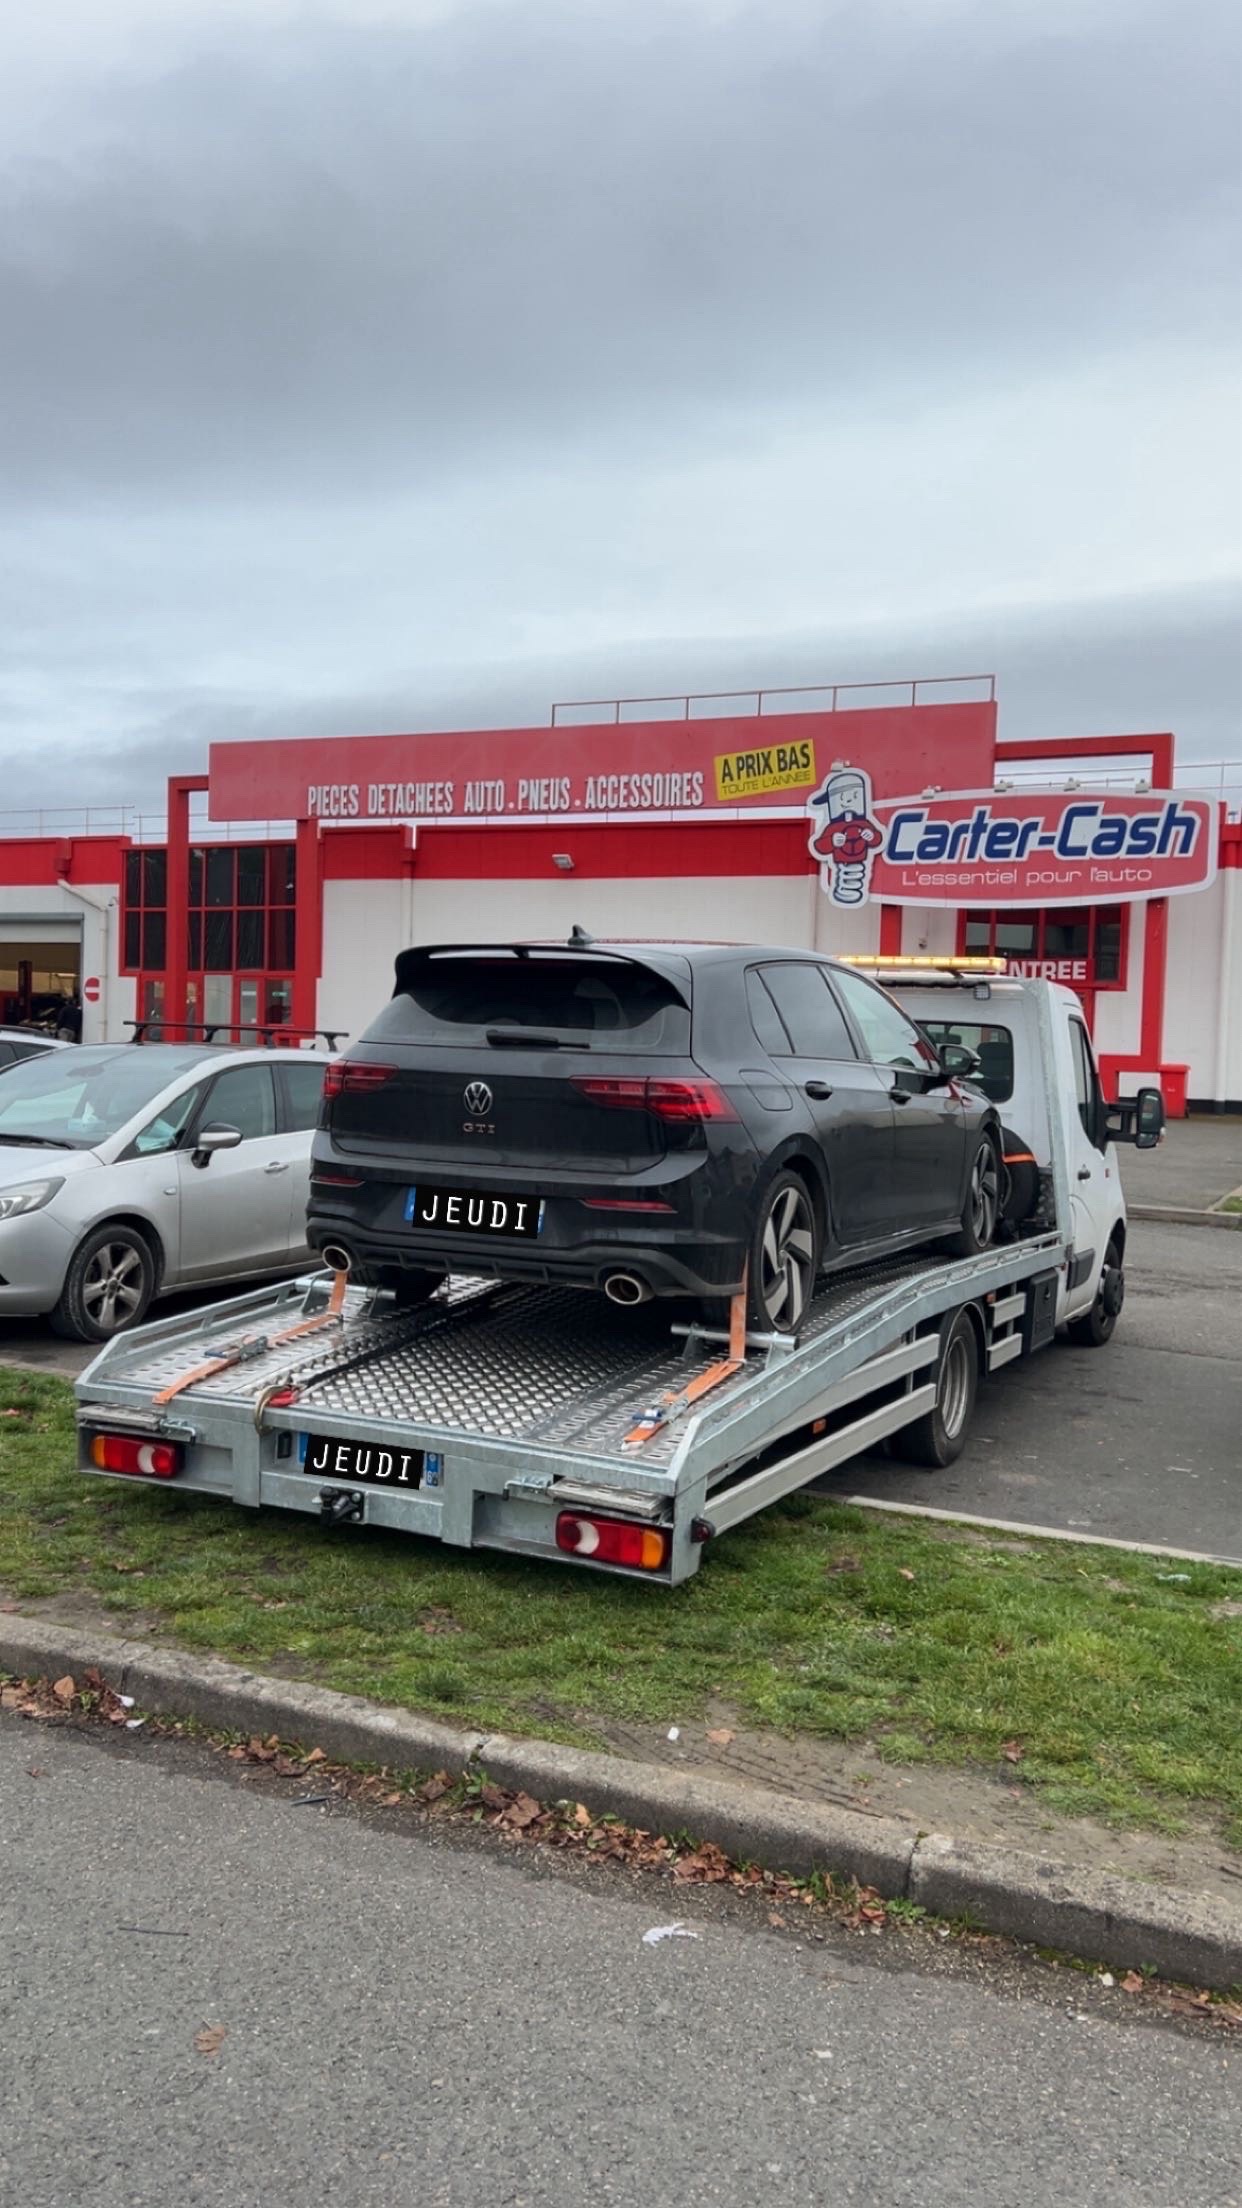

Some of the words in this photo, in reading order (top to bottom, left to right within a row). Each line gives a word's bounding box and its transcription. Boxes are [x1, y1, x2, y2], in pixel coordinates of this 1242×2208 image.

[721, 758, 734, 783] A
[736, 751, 773, 780] PRIX
[776, 743, 810, 773] BAS
[308, 783, 359, 816] PIECES
[368, 781, 454, 815] DETACHEES
[464, 779, 504, 813] AUTO
[518, 777, 570, 811] PNEUS
[585, 771, 704, 809] ACCESSOIRES
[722, 781, 759, 795] TOUTE
[884, 803, 1196, 863] Carter-Cash
[902, 869, 1018, 886] L'essentiel
[1026, 870, 1082, 885] pour
[1090, 867, 1153, 883] l'auto
[1006, 960, 1087, 980] NTREE
[463, 1122, 496, 1134] GTI
